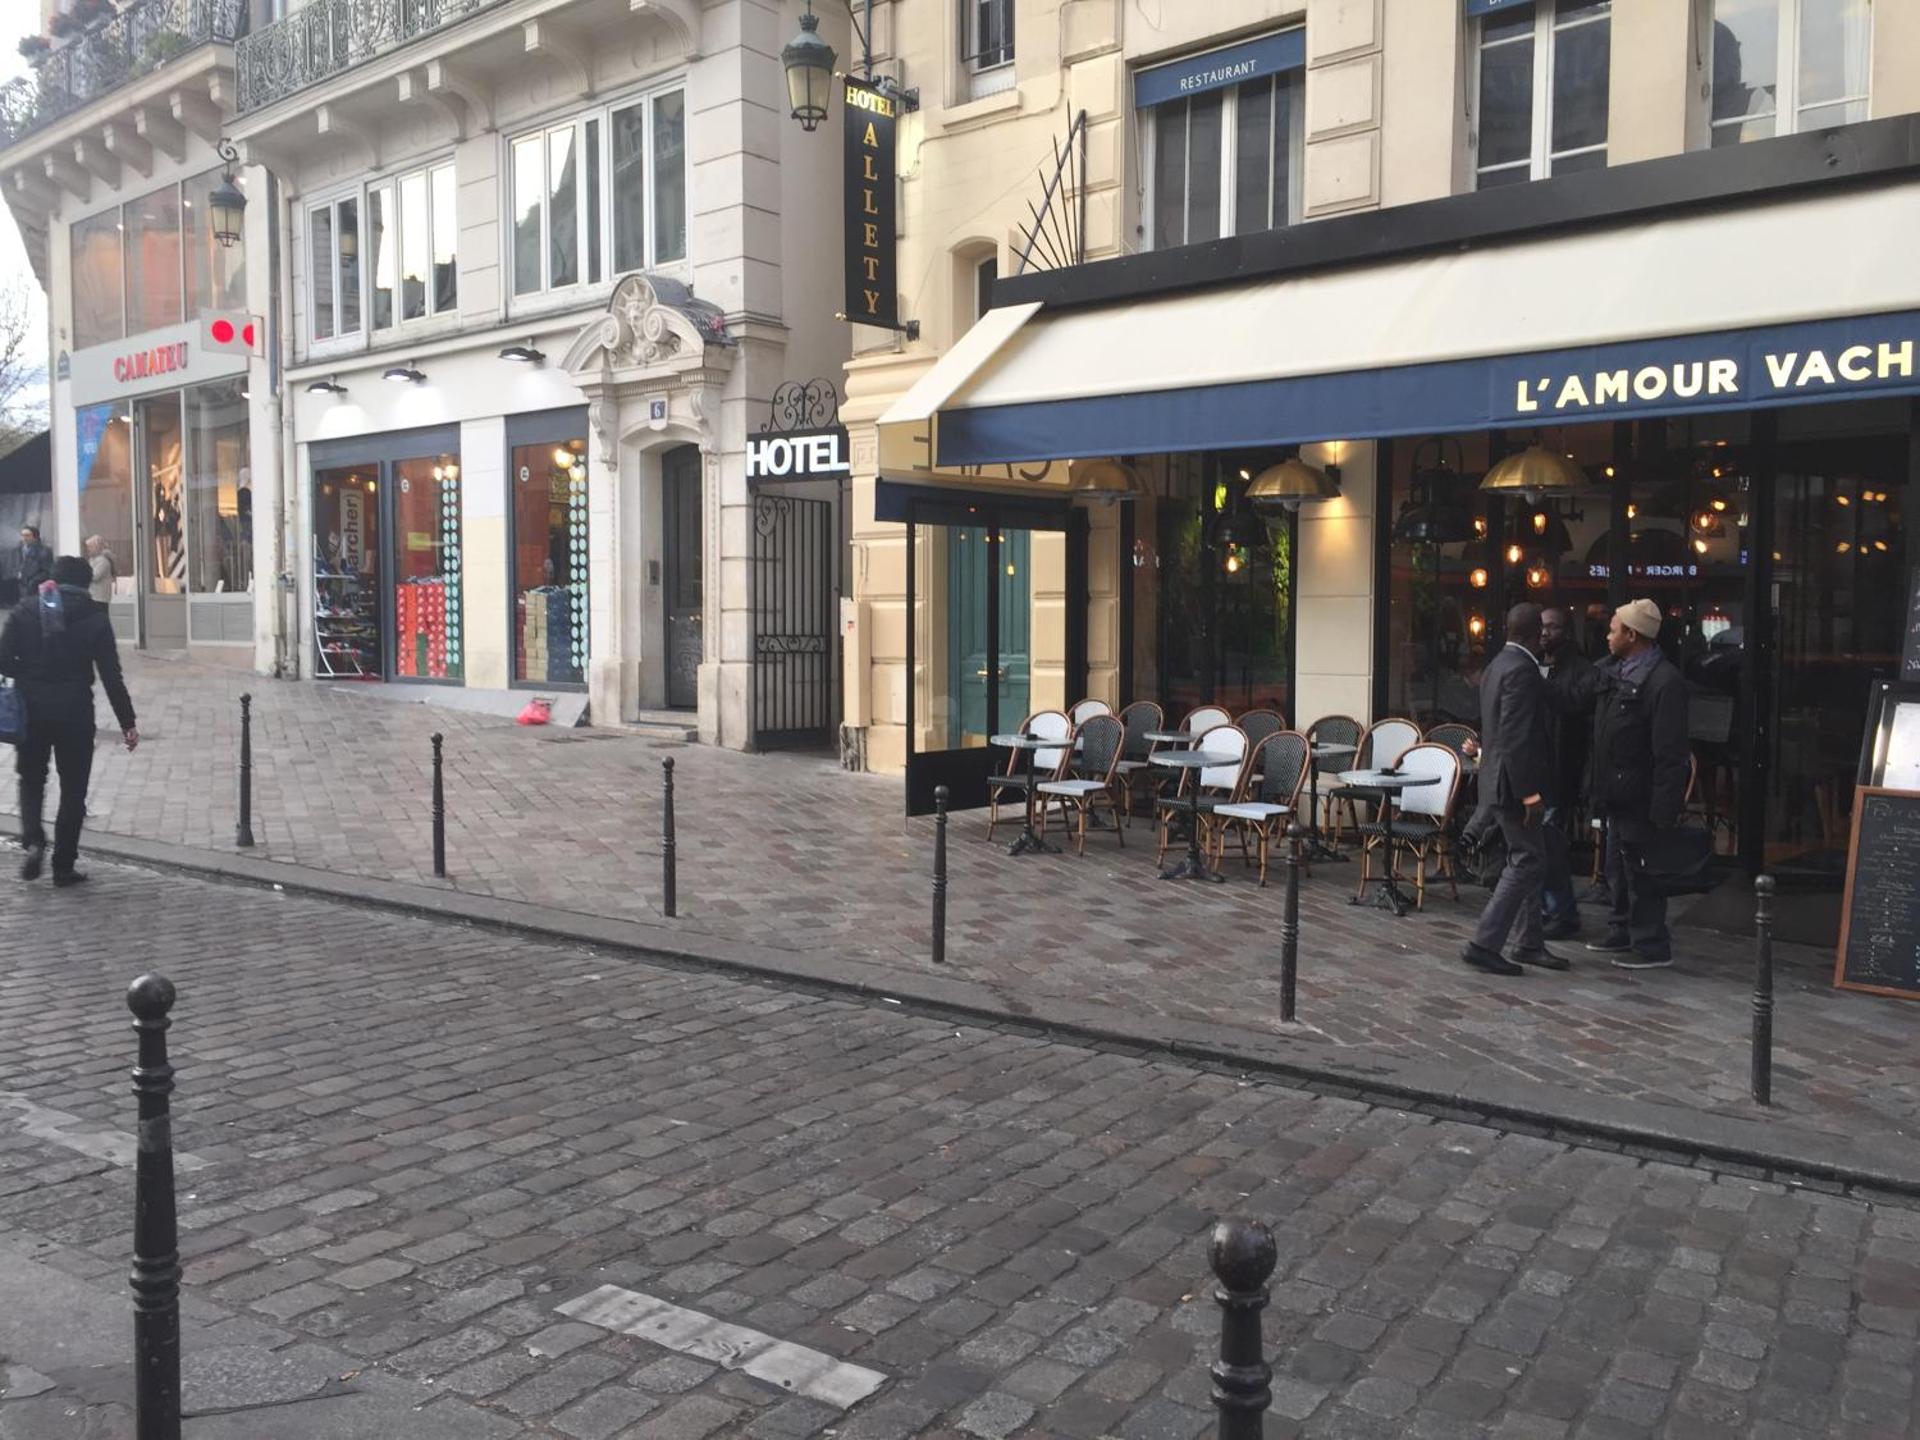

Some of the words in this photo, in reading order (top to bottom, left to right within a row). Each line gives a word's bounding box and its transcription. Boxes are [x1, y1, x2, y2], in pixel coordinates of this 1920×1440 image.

[1179, 59, 1257, 92] RESTAURANT
[846, 86, 895, 118] HOTEL
[863, 121, 880, 315] ALLETY
[1516, 358, 1739, 412] L'AMOUR
[1764, 341, 1913, 388] VACH
[653, 401, 662, 418] 6
[746, 434, 850, 477] HOTEL
